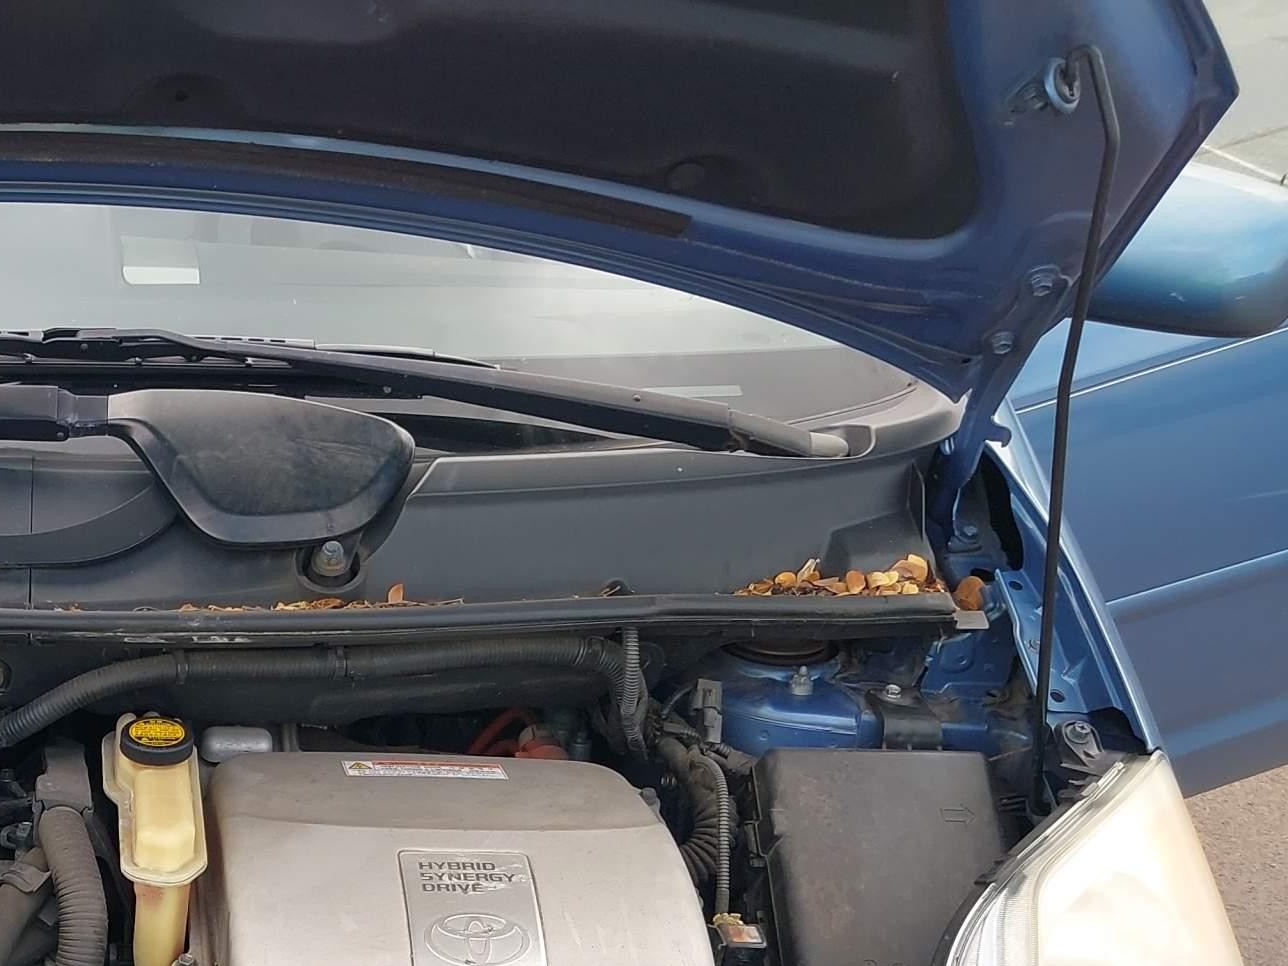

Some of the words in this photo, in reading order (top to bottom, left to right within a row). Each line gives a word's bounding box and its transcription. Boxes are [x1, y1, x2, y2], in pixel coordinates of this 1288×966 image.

[418, 861, 496, 871] HYBRID
[420, 872, 516, 882] SYNERGY
[422, 883, 485, 893] DRIVE
